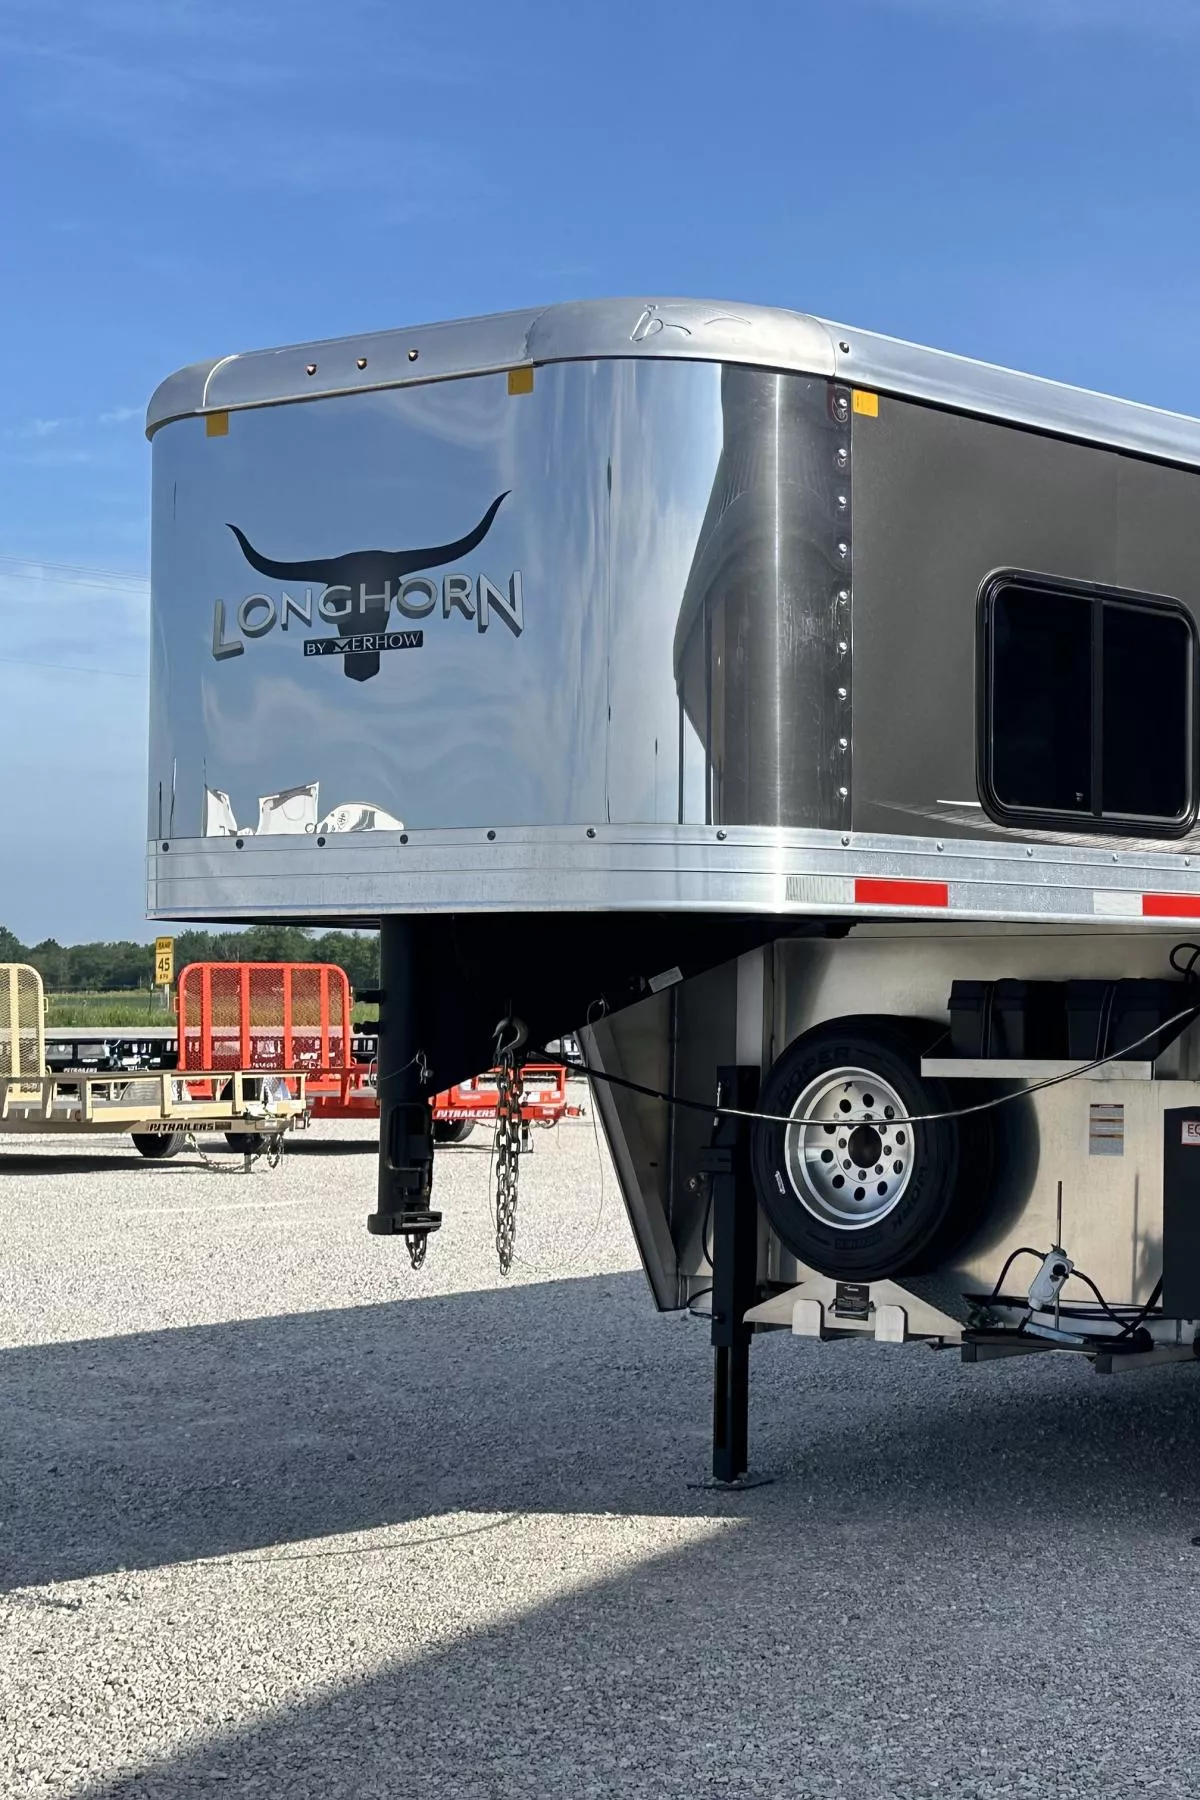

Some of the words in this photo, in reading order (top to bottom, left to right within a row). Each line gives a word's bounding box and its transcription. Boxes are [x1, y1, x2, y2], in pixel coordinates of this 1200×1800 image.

[212, 569, 524, 661] LONGHORN
[306, 643, 326, 655] BY
[332, 631, 421, 653] MERHOW
[158, 957, 170, 971] 45
